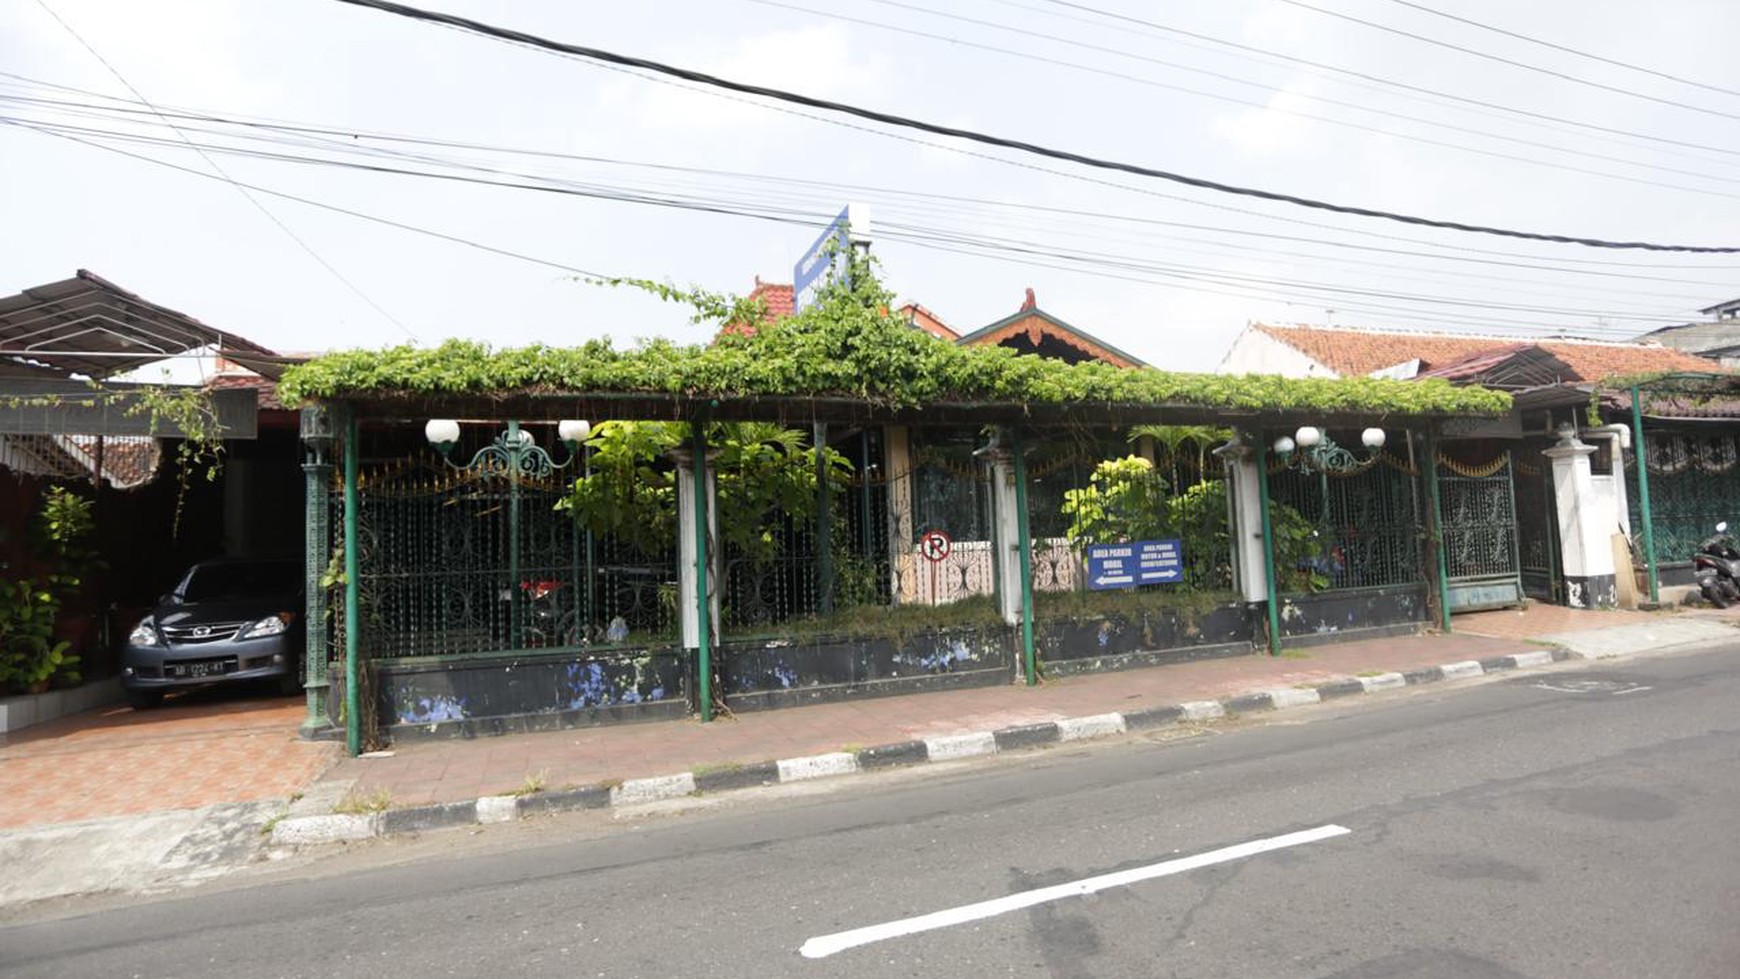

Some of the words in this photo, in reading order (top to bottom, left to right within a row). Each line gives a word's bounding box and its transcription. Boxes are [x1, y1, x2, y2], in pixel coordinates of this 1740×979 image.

[1092, 549, 1108, 558] AREA
[1109, 548, 1132, 557] PARKIR
[1103, 559, 1123, 569] MOBIL
